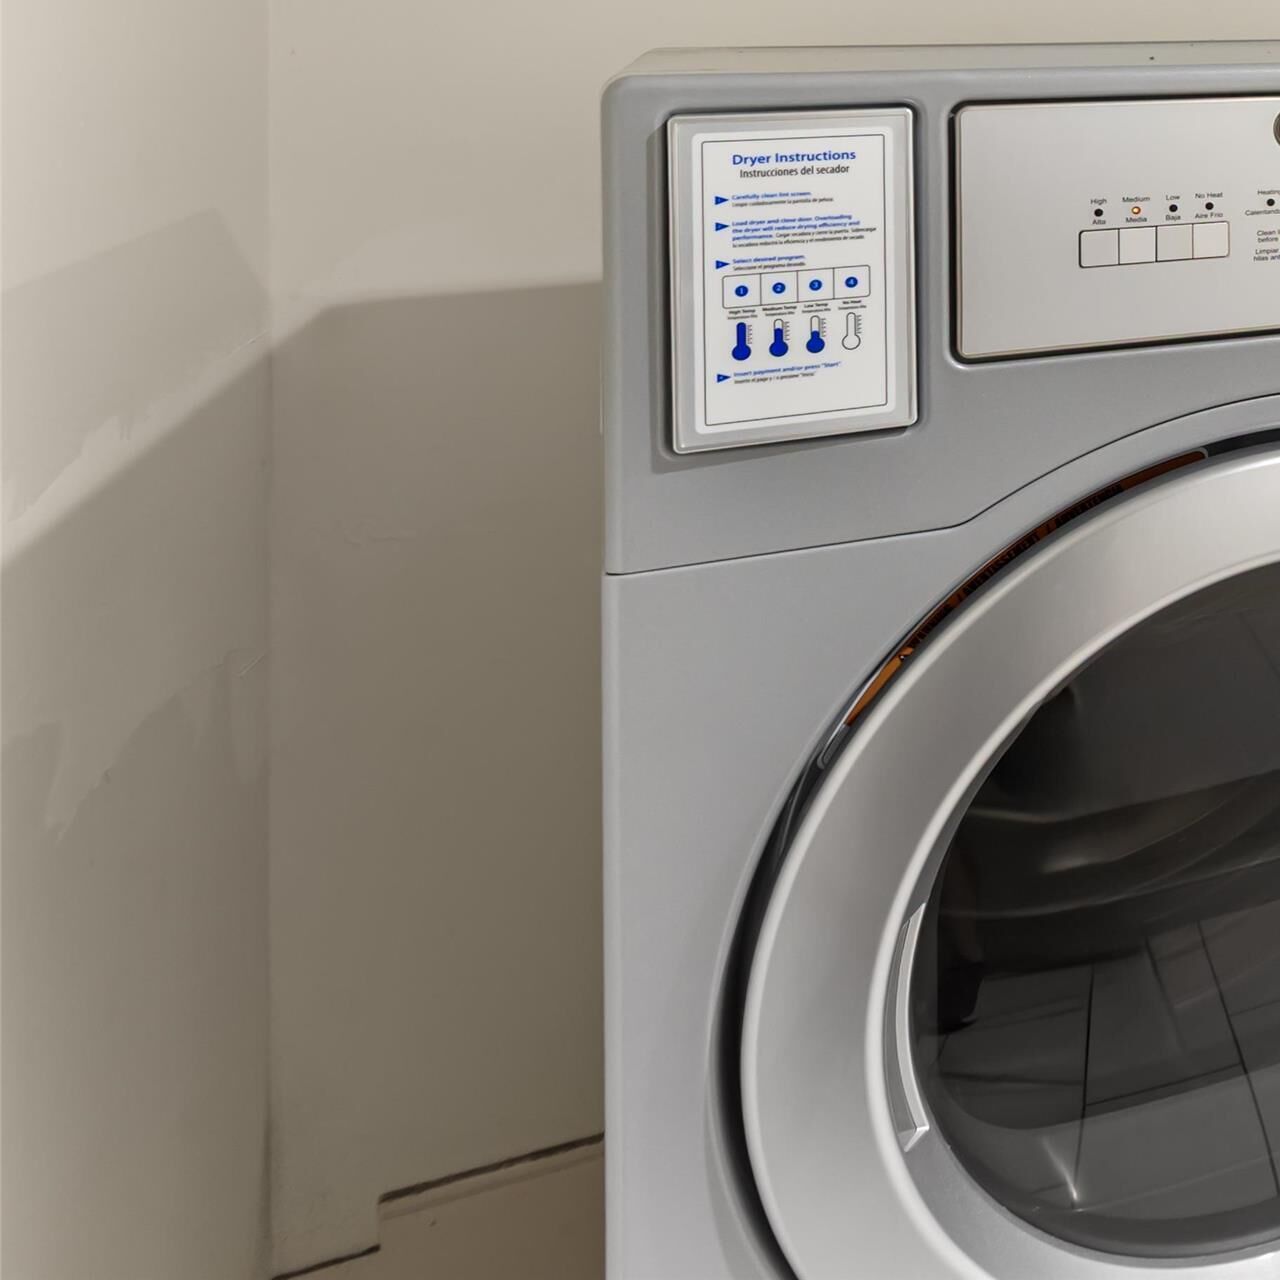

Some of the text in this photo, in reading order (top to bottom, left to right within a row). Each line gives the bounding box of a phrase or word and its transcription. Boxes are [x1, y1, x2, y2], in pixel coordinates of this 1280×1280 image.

[732, 150, 856, 167] Dryer Instructions
[739, 165, 850, 178] Instrucciones del secador
[1122, 195, 1150, 203] Medium
[1206, 191, 1223, 199] Heat
[1090, 198, 1107, 206] High
[1165, 214, 1181, 222] Baja
[1257, 229, 1276, 237] Clean
